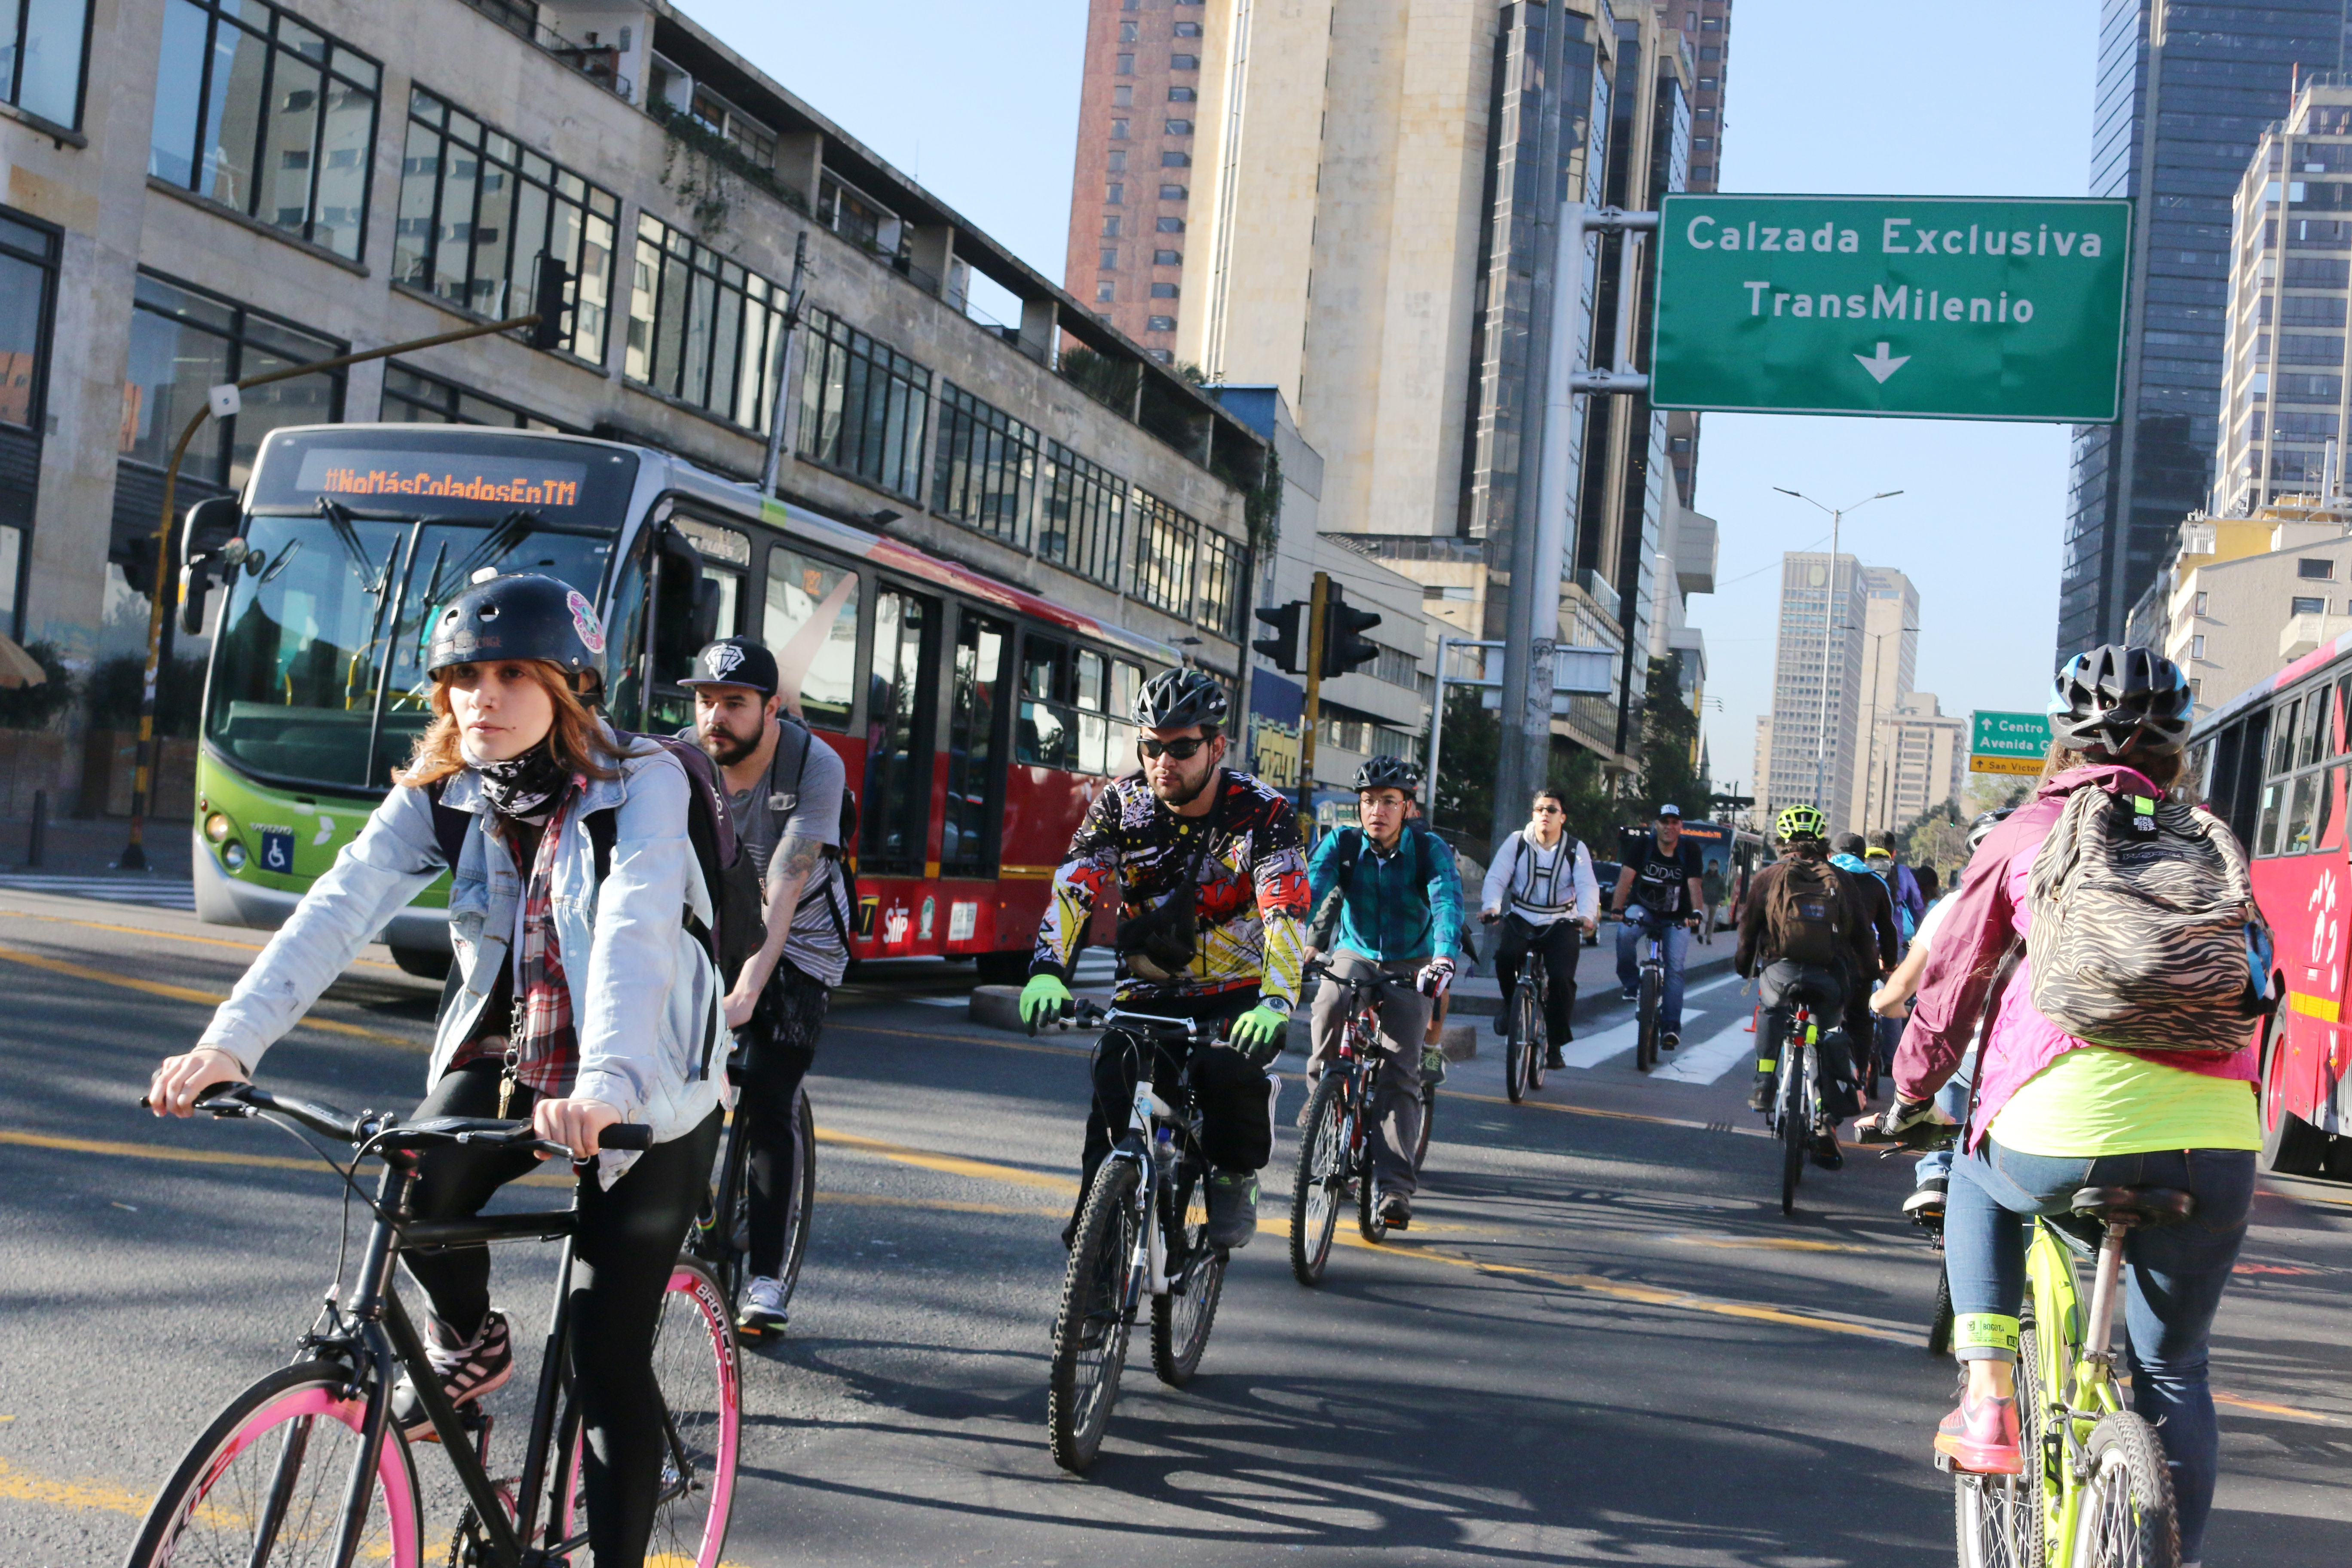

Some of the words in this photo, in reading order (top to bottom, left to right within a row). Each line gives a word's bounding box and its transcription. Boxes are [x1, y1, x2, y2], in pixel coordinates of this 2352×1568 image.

[1686, 215, 1859, 253] Calzada
[1882, 217, 2101, 257] Exclusiva
[1743, 281, 2034, 323] TransMilenio
[324, 468, 577, 505] #NoMásColadosEnTM
[1999, 720, 2043, 733] Centro
[1979, 736, 2034, 750] Avenida
[1989, 762, 2006, 770] San
